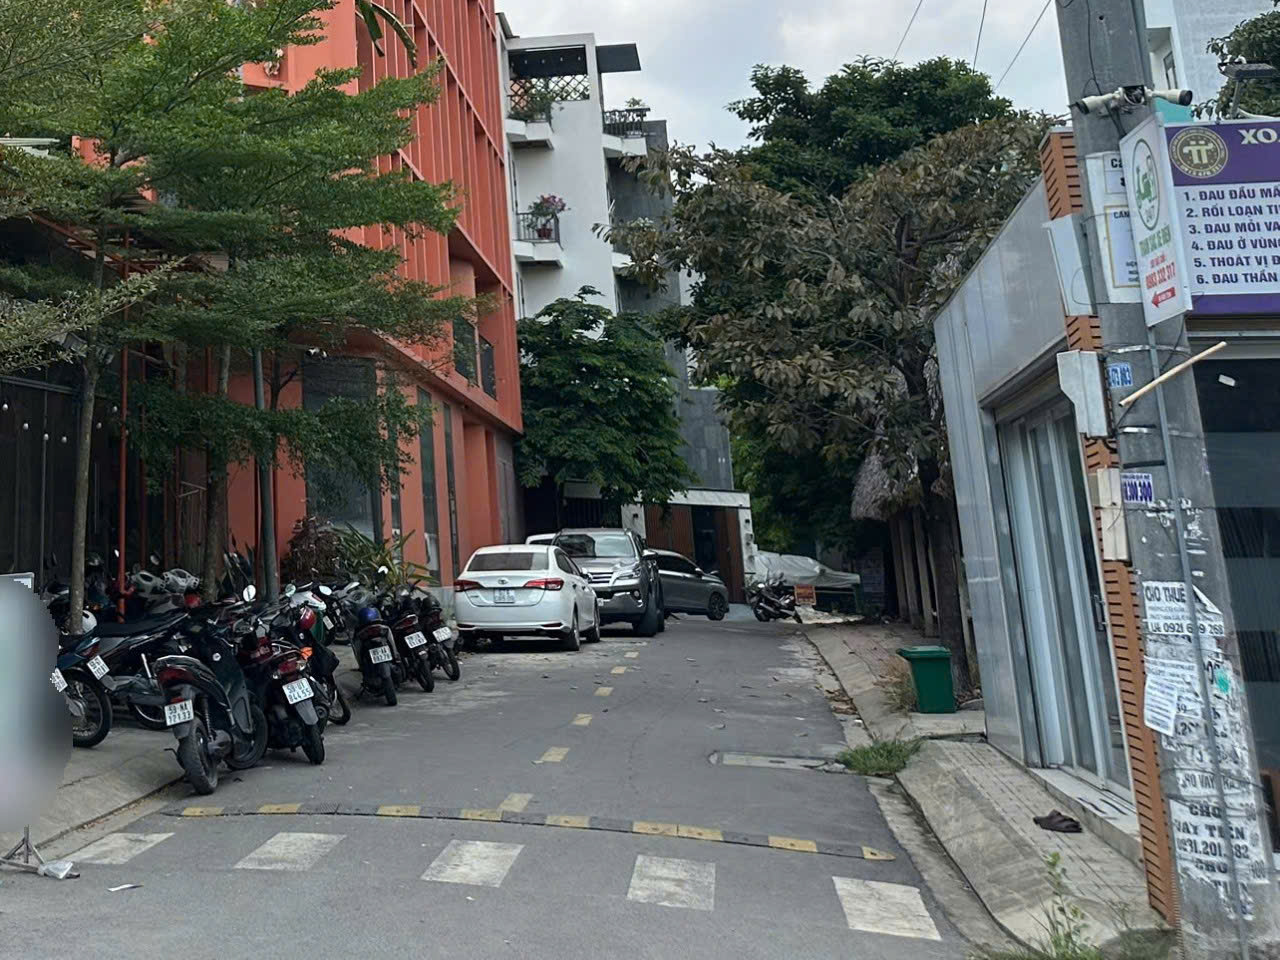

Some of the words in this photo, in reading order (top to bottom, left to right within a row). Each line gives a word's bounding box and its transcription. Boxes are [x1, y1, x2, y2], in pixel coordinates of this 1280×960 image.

[1238, 128, 1280, 145] XO
[1199, 190, 1225, 201] ĐAU
[1186, 208, 1198, 218] 2.
[1228, 205, 1263, 219] LOẠN
[1189, 224, 1200, 234] 3.
[1205, 224, 1230, 234] ĐAU
[1191, 241, 1203, 251] 4.
[1207, 240, 1233, 250] ĐAU
[1194, 258, 1206, 268] 5.
[1209, 254, 1251, 267] THOÁT
[1196, 274, 1209, 284] 6.
[1212, 273, 1238, 284] ĐAU
